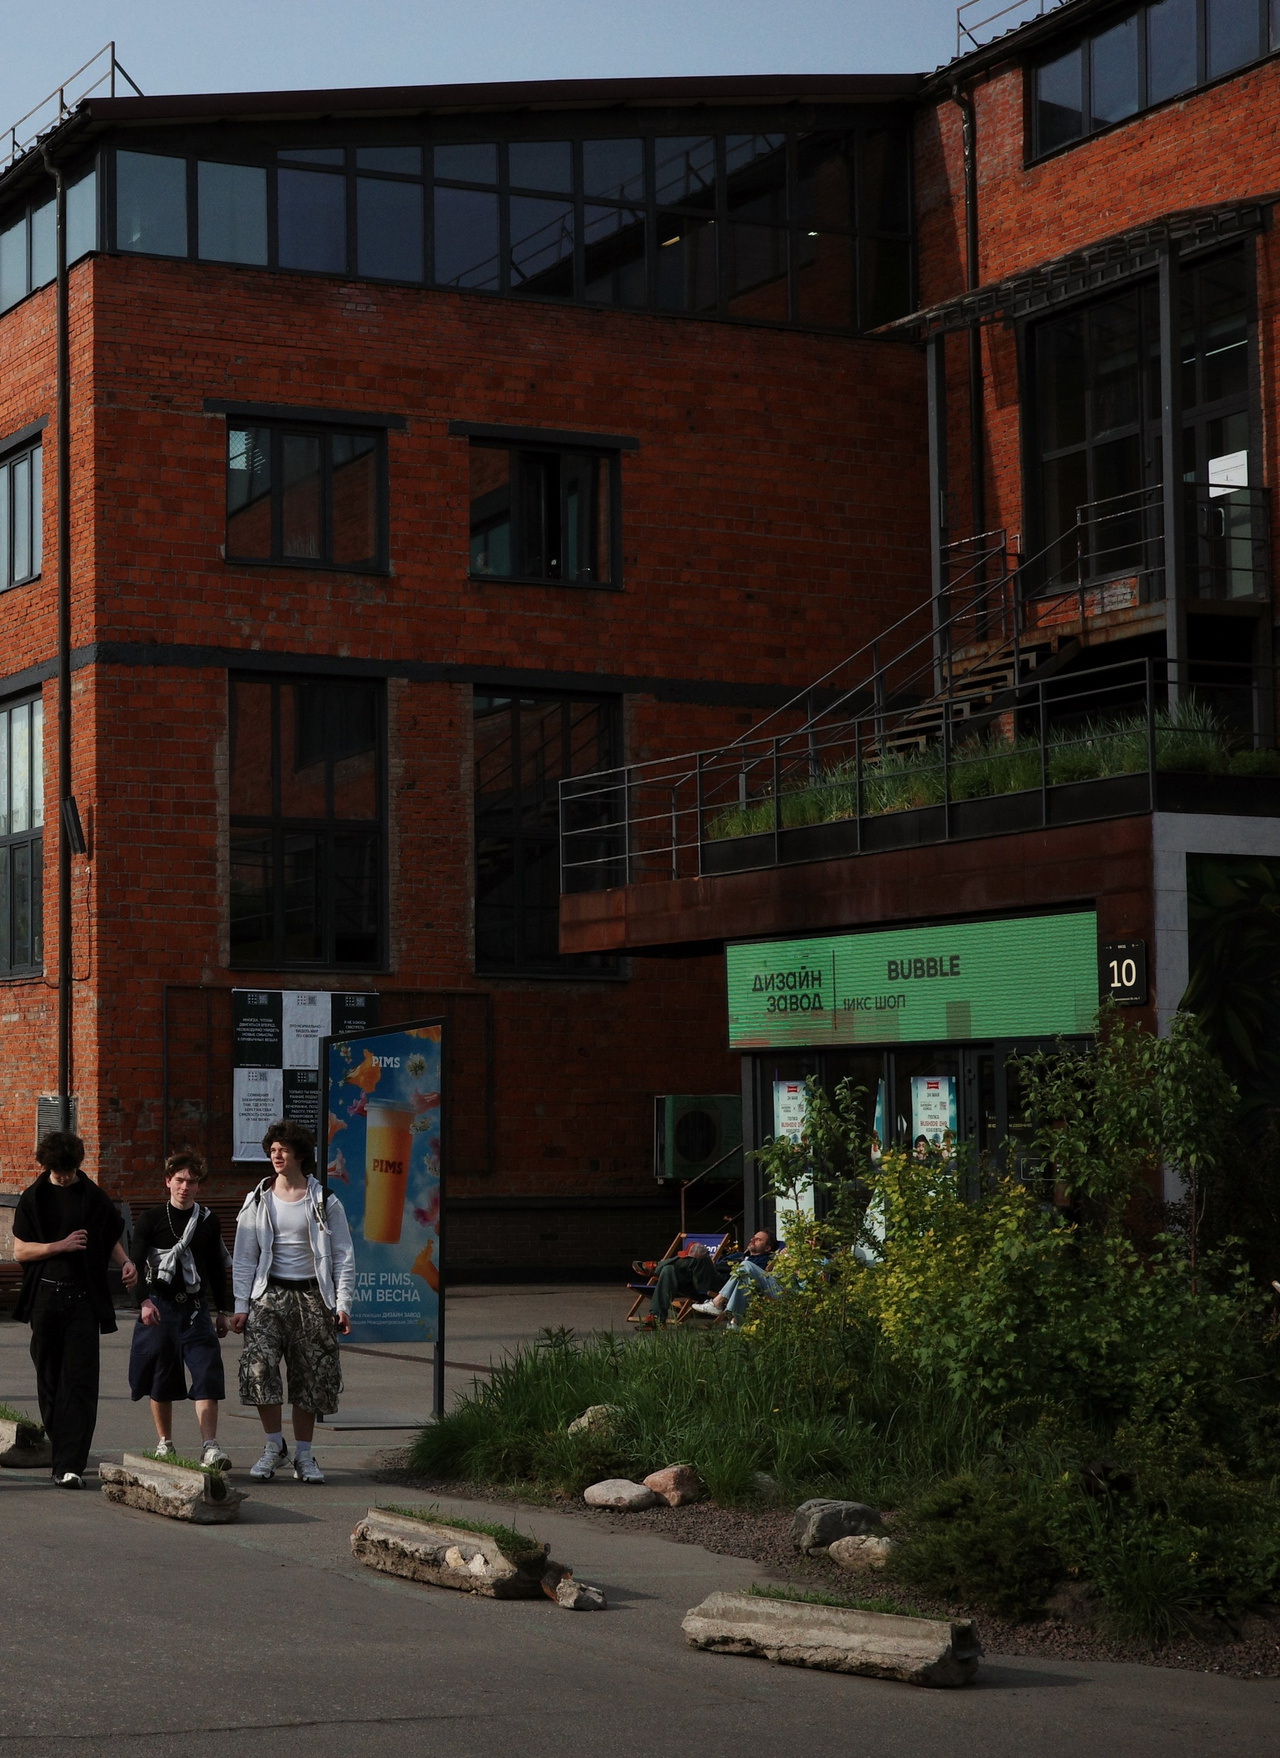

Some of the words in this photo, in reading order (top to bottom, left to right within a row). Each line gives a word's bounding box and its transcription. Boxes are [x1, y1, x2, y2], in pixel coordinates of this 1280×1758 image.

[887, 955, 961, 981] BUBBLE
[1109, 959, 1137, 988] 10
[875, 995, 906, 1010] ШОП
[372, 1056, 401, 1068] PIMS
[372, 1159, 403, 1175] PIMS
[352, 1289, 372, 1302] АМ
[376, 1289, 421, 1302] ВЕСНА
